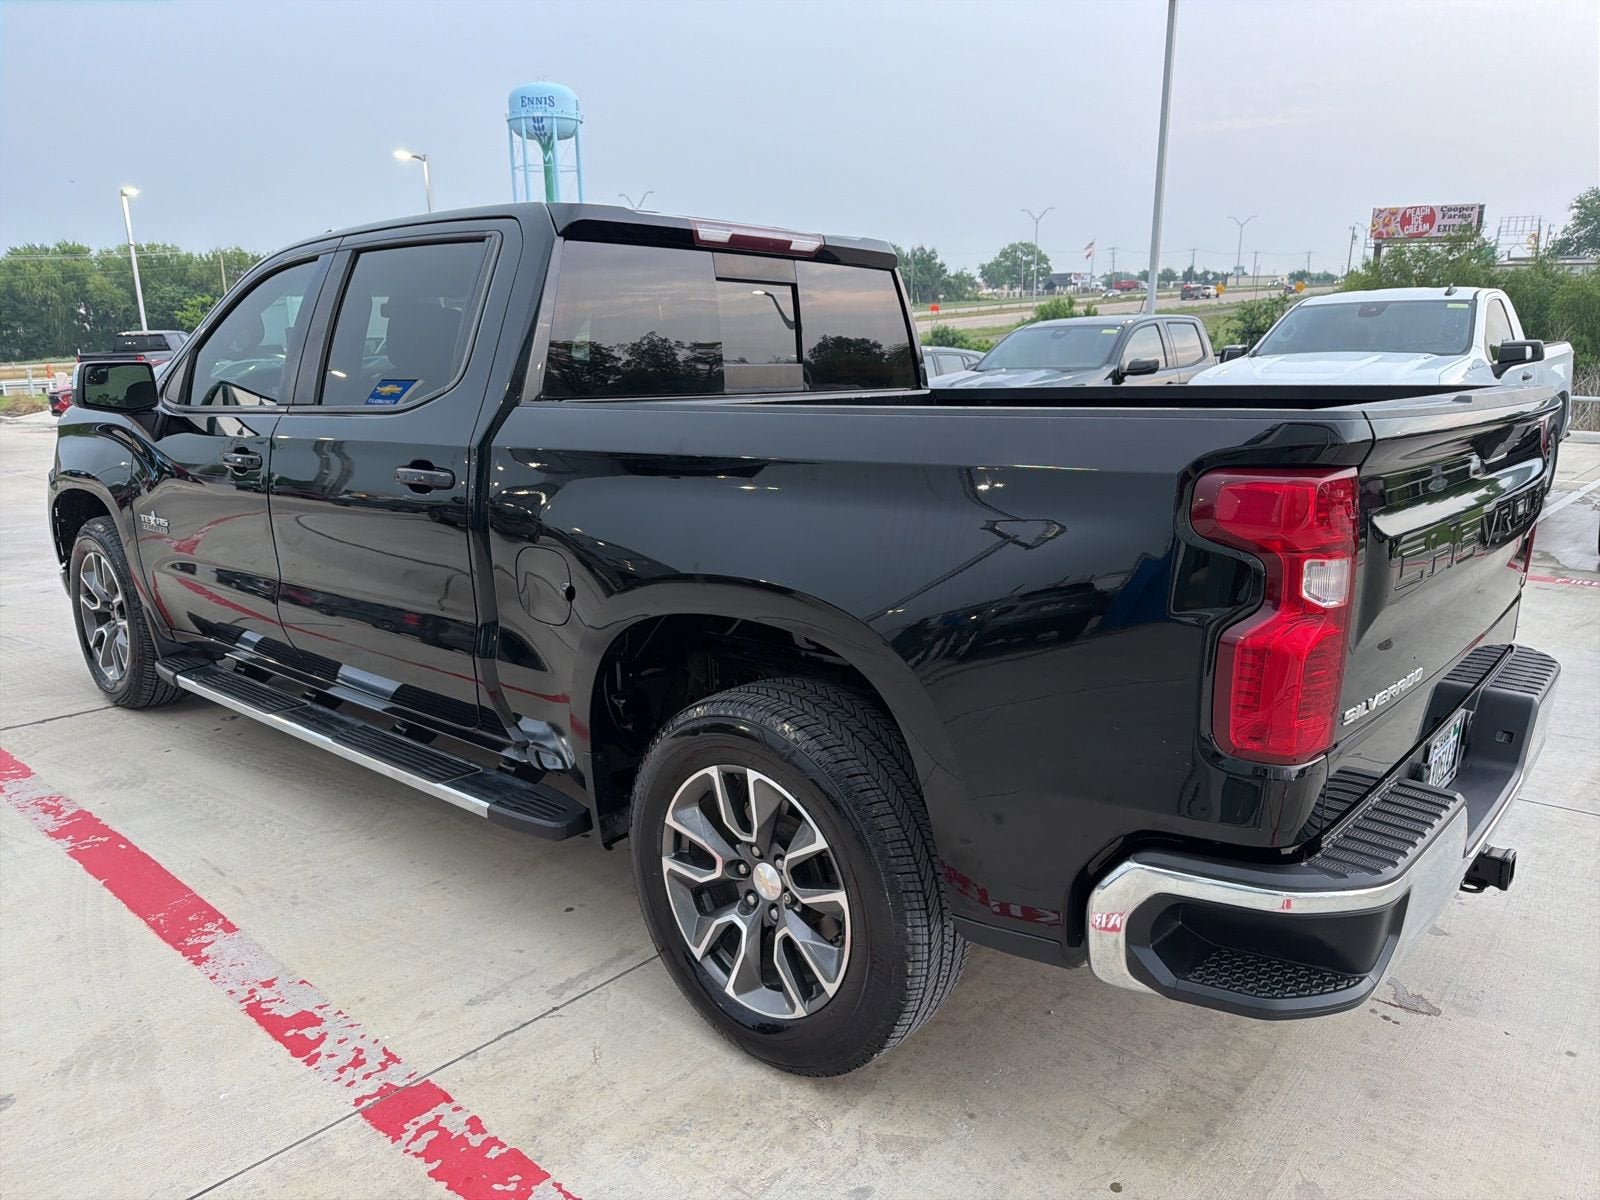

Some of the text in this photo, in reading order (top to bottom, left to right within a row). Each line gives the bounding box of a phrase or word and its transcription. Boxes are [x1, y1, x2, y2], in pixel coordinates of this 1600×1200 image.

[520, 95, 555, 107] ENNIS
[1406, 206, 1431, 217] PEACH
[1440, 205, 1476, 213] Cooper
[1411, 215, 1424, 225] ICE
[1441, 212, 1473, 220] Farms
[1404, 223, 1430, 234] CREAM
[139, 510, 169, 527] TEXAS
[1342, 667, 1424, 727] SILVERADO
